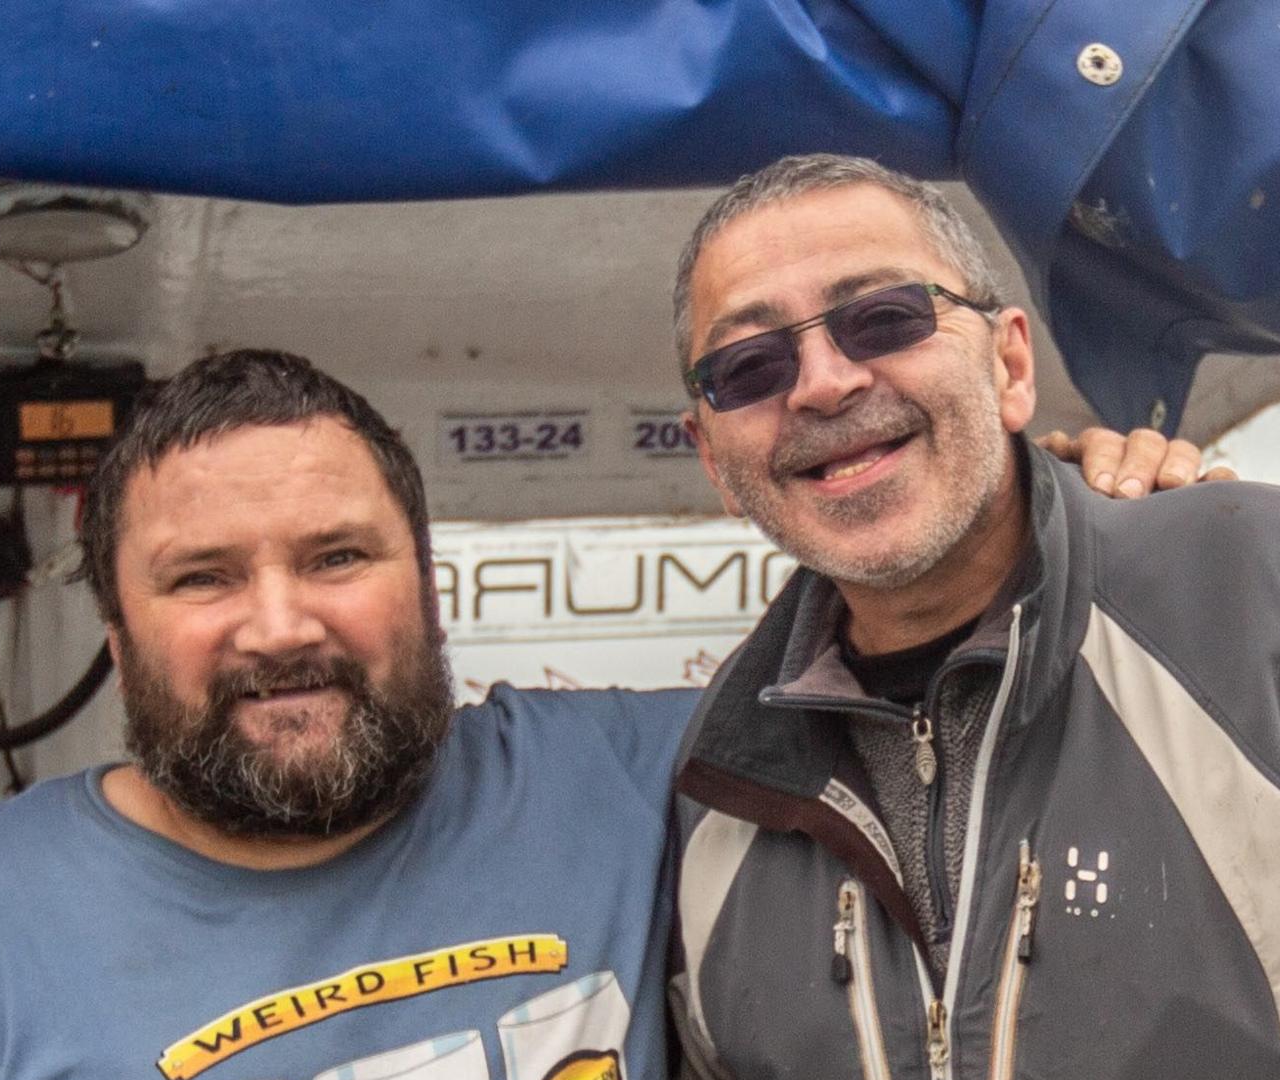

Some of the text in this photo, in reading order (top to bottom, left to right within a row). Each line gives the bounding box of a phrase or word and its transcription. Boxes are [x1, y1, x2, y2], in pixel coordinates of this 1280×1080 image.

[450, 422, 583, 453] 133-24
[194, 941, 536, 1055] WEIRD FISH
